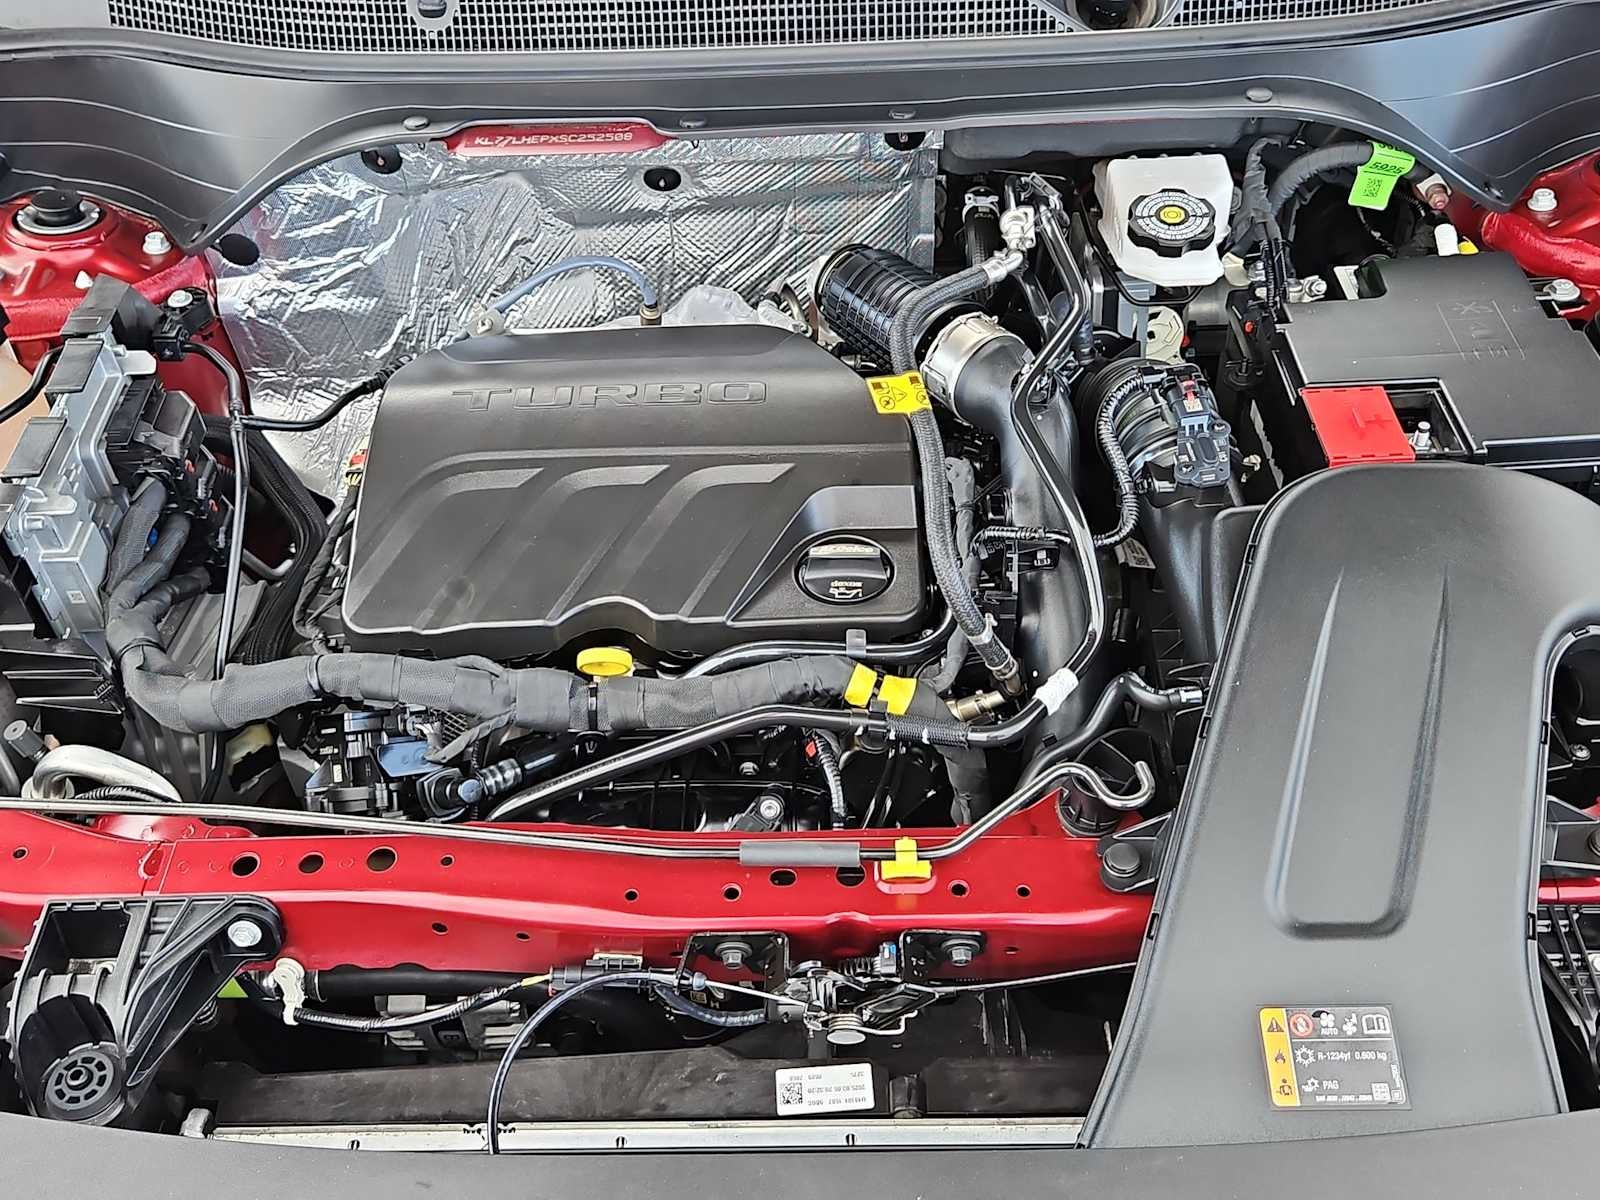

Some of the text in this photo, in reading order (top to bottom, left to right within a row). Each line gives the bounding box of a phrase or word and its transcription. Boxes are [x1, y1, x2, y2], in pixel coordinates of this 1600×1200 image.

[1369, 161, 1406, 175] 5925
[452, 381, 768, 413] TURBO
[1320, 1027, 1339, 1036] AUTO
[1317, 1050, 1351, 1062] R-1234yf
[1376, 1051, 1387, 1062] kg
[1322, 1080, 1340, 1090] PAG
